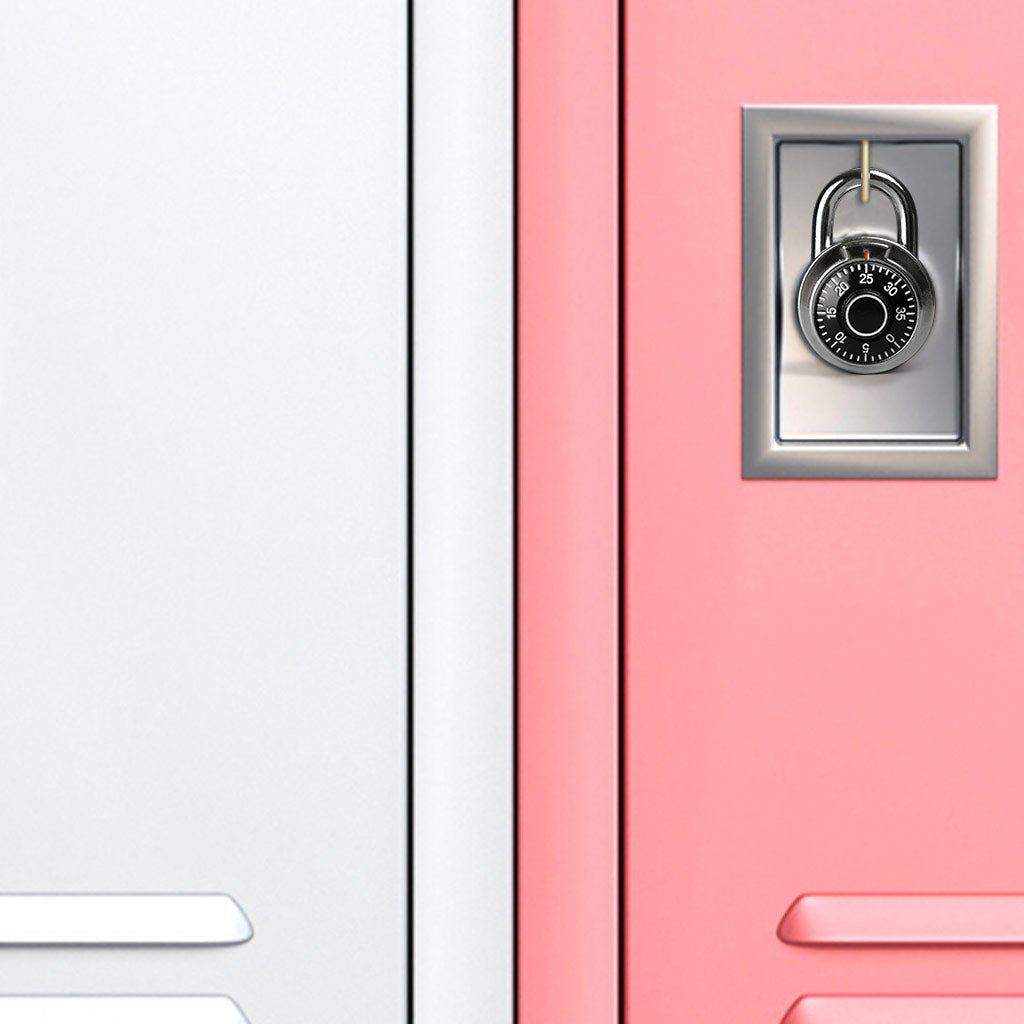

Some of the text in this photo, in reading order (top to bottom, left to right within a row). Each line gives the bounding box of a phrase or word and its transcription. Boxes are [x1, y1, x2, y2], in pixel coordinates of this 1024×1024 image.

[859, 273, 874, 284] 25
[834, 281, 849, 297] 20
[883, 282, 898, 296] 30
[826, 307, 837, 320] 15
[895, 306, 906, 321] 35
[834, 331, 848, 344] 10
[862, 342, 870, 354] 5
